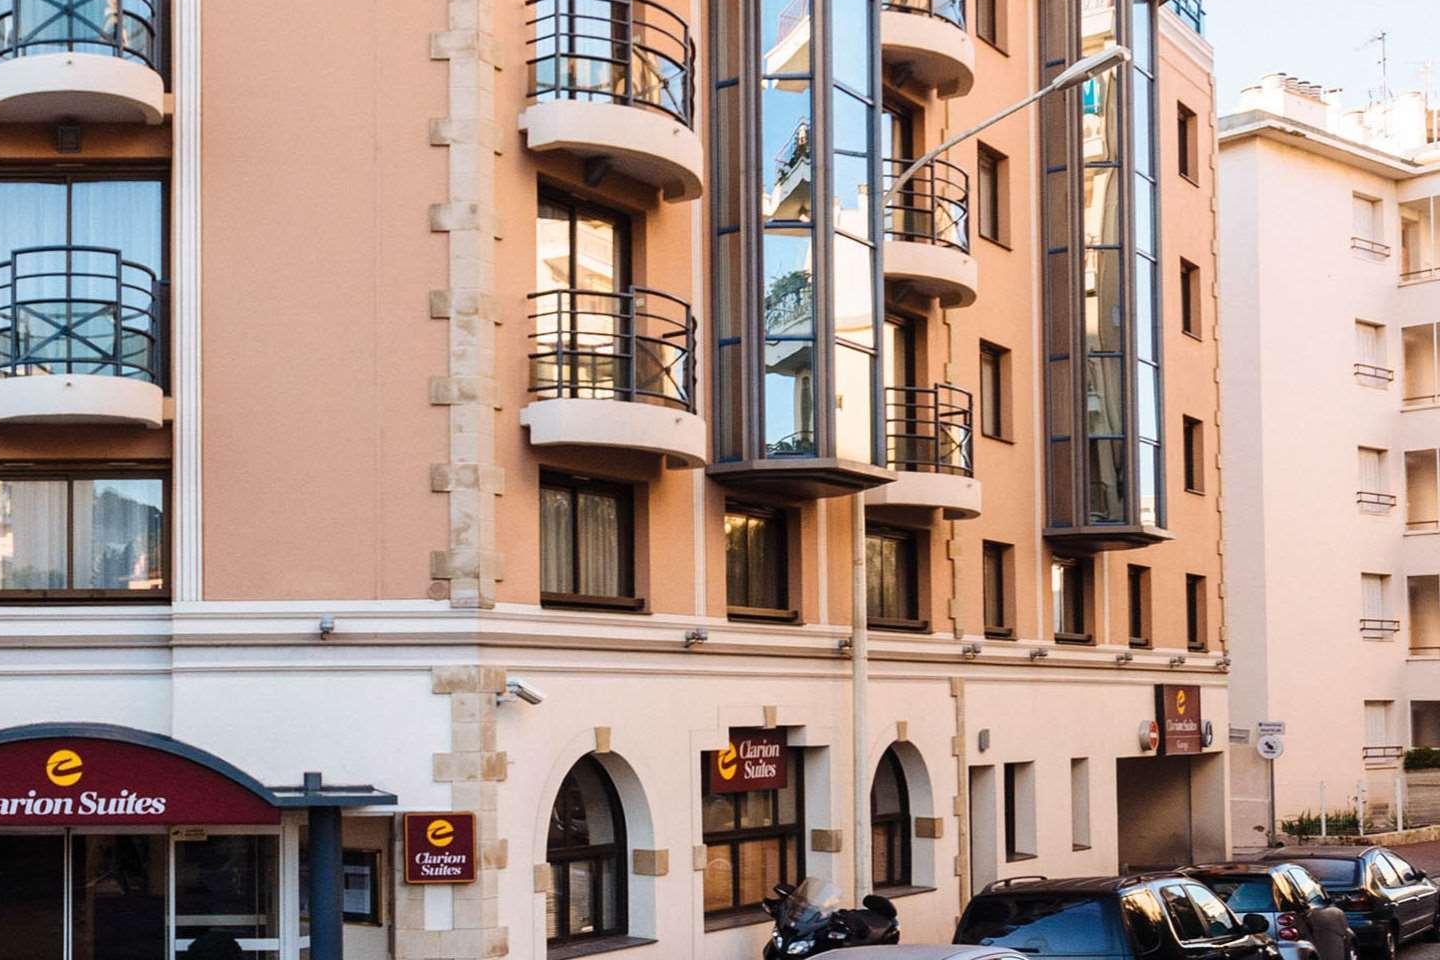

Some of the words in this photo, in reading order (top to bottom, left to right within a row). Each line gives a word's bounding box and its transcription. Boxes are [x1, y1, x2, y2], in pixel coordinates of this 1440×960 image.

[739, 739, 780, 759] Clarion
[743, 759, 777, 780] Suites
[78, 789, 167, 816] Suites
[415, 851, 467, 865] Clarion
[420, 863, 462, 877] Suites
